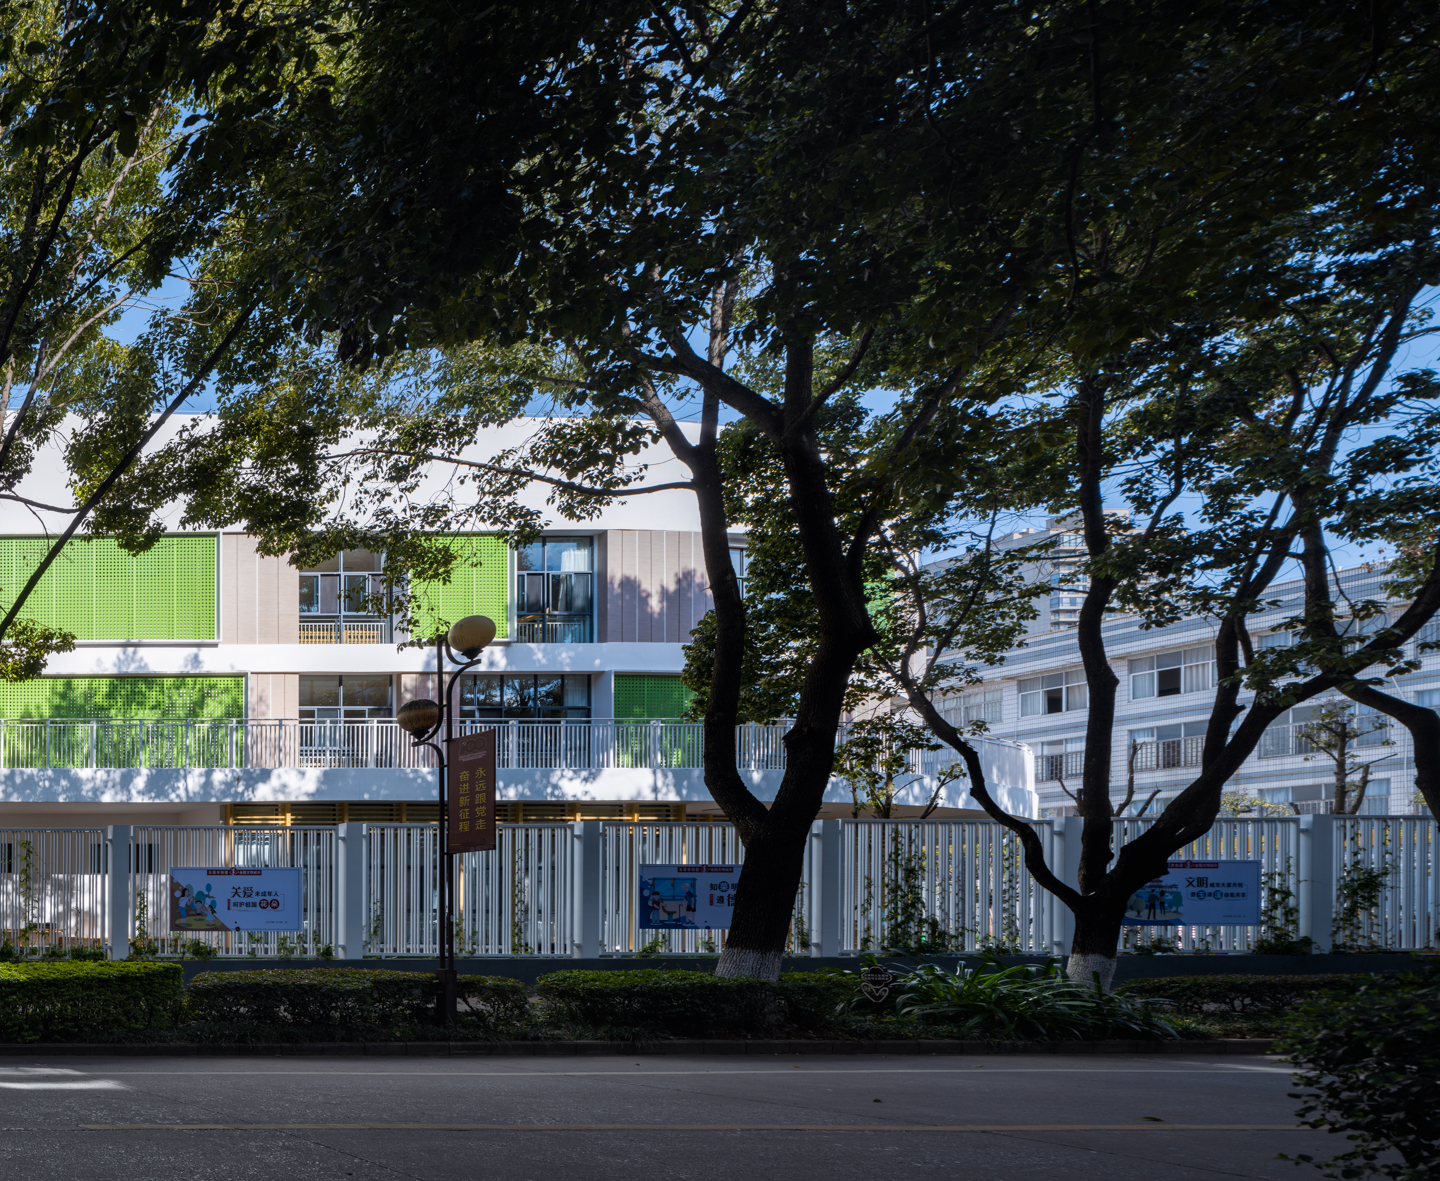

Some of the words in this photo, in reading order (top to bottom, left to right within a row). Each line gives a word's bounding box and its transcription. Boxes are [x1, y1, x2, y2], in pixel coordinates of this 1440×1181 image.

[459, 770, 470, 832] 奋进新征程
[475, 767, 487, 831] 永远跟党走
[231, 886, 279, 898] 关爱未成年人
[232, 899, 280, 909] 呵护祖国花朵
